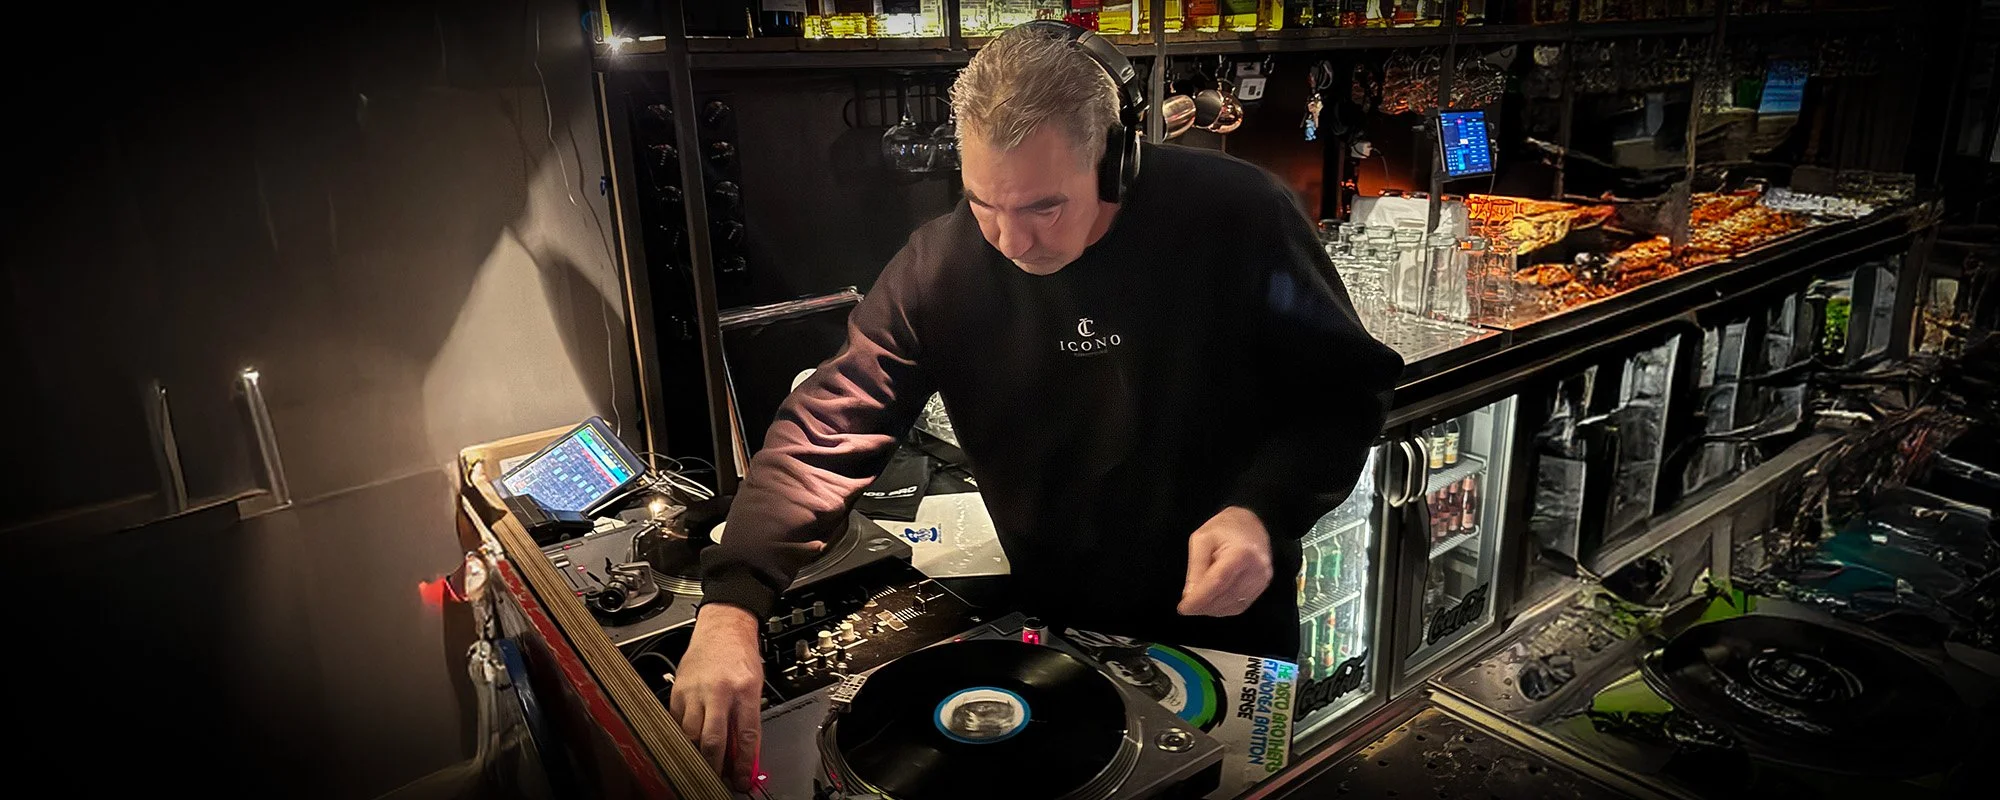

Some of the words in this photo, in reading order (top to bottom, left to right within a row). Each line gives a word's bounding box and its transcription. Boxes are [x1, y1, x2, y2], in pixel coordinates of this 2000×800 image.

[1059, 334, 1121, 352] ICONO
[1244, 657, 1262, 684] INNER
[1237, 686, 1257, 721] SENSE
[1255, 671, 1276, 714] ANDREA
[1247, 715, 1270, 765] BRITTON
